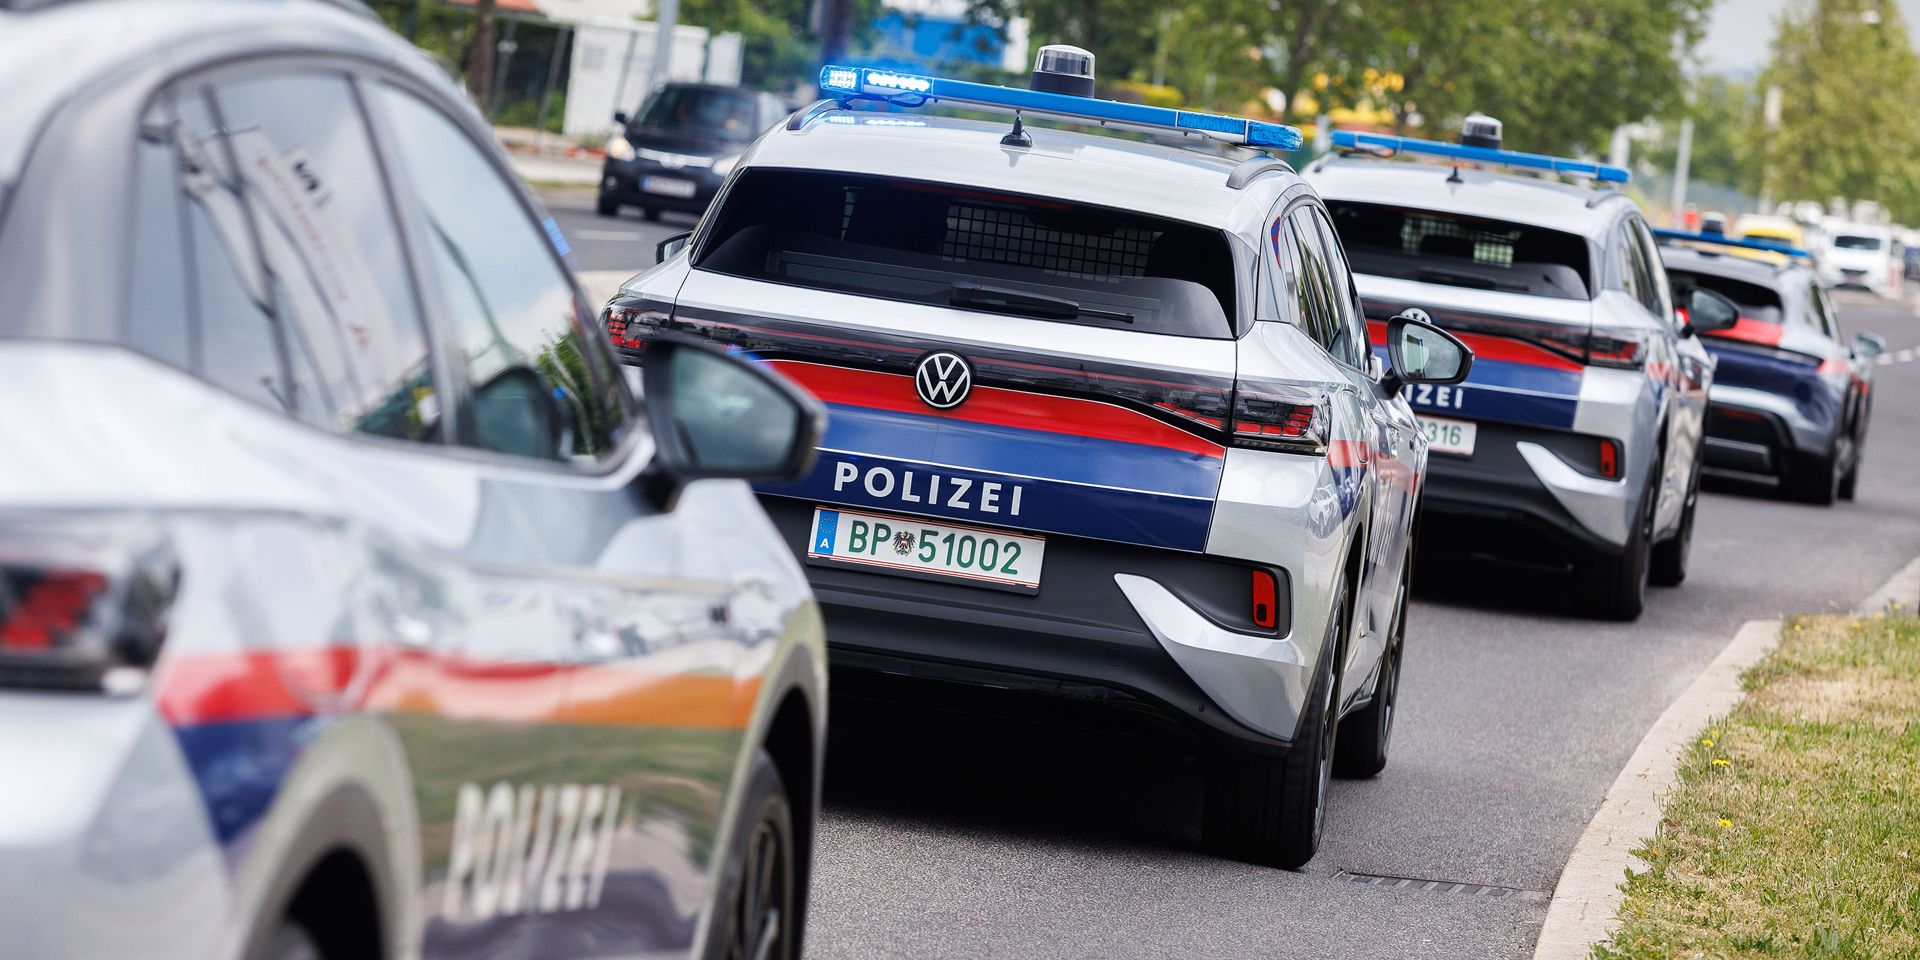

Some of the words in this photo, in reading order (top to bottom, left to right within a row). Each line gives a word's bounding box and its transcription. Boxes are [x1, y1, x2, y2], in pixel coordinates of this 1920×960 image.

[918, 353, 970, 405] VW
[1405, 384, 1464, 409] IZEI
[1420, 421, 1462, 446] 316
[834, 461, 1022, 516] POLIZEI
[819, 538, 830, 549] A
[849, 520, 892, 555] BP
[918, 529, 1021, 575] 51002
[441, 779, 622, 923] POLIZEI
